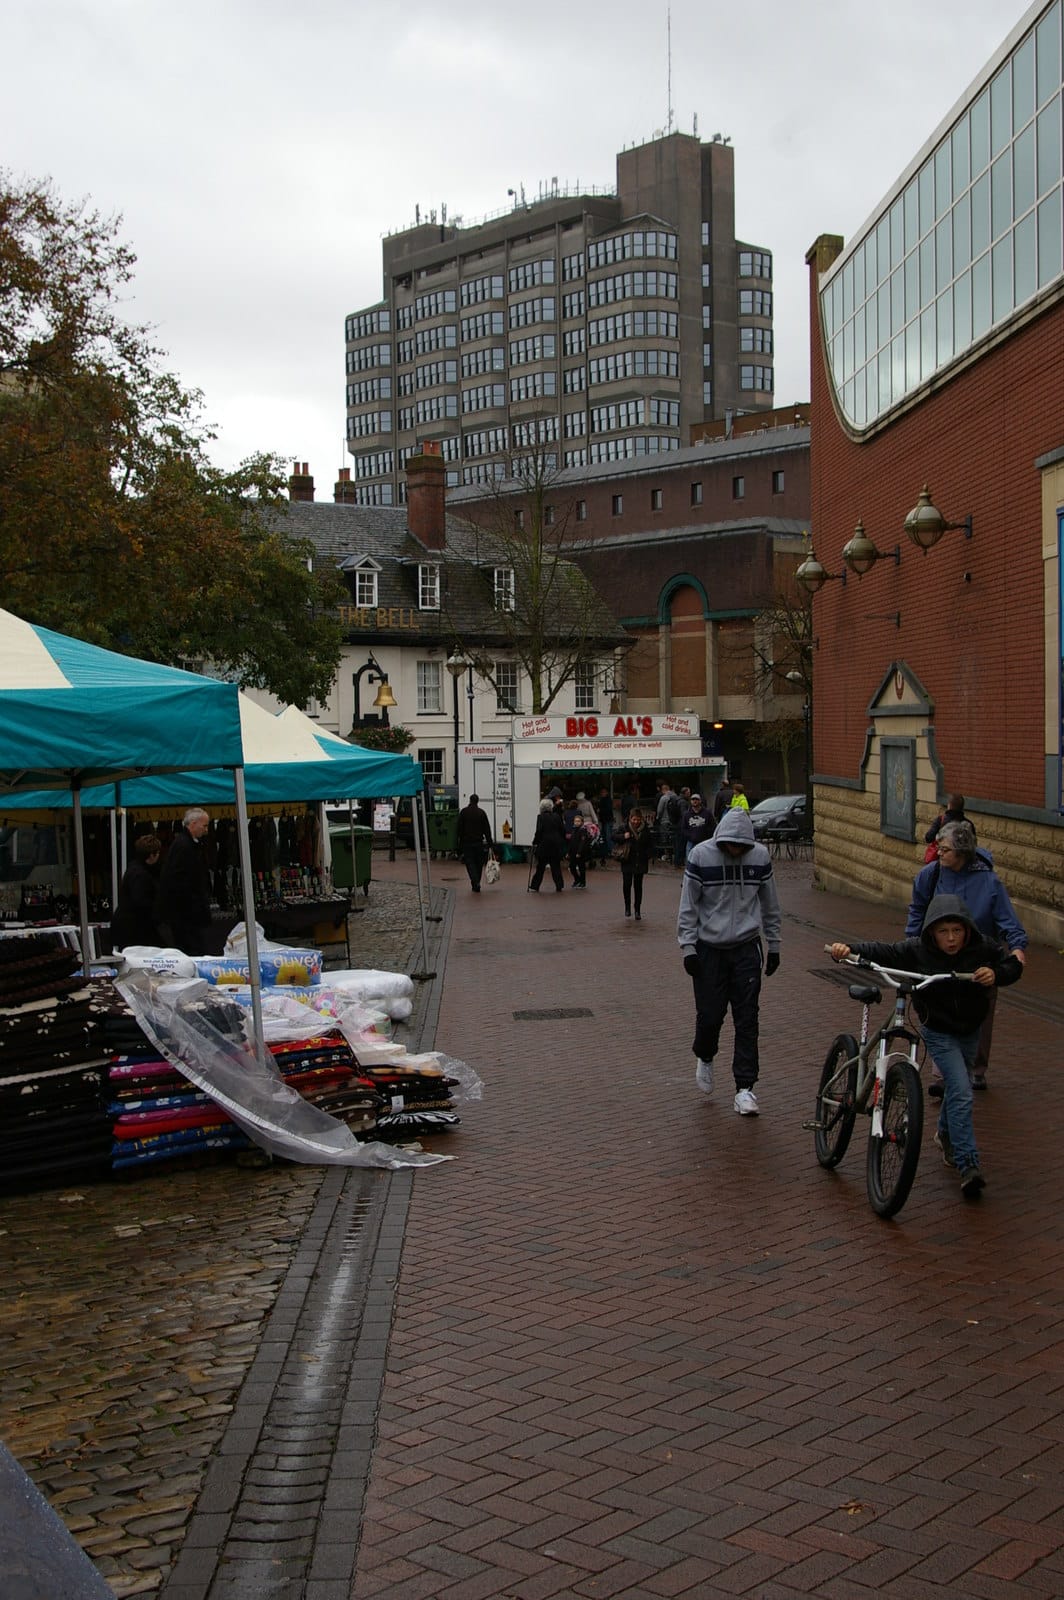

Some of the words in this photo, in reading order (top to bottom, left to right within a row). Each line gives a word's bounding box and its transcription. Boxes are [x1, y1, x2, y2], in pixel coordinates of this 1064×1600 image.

[337, 606, 370, 627] THE
[377, 607, 420, 629] BELL
[522, 720, 534, 729] Hot
[534, 717, 548, 726] and
[565, 716, 599, 737] BIG
[613, 716, 653, 737] AL'S
[666, 714, 677, 723] Hot
[677, 718, 689, 726] and
[521, 728, 535, 738] cold
[536, 724, 551, 734] food
[661, 722, 674, 731] cold
[674, 725, 691, 735] drinks
[464, 746, 504, 754] Refreshments
[557, 743, 580, 751] Probably
[211, 965, 253, 979] duve
